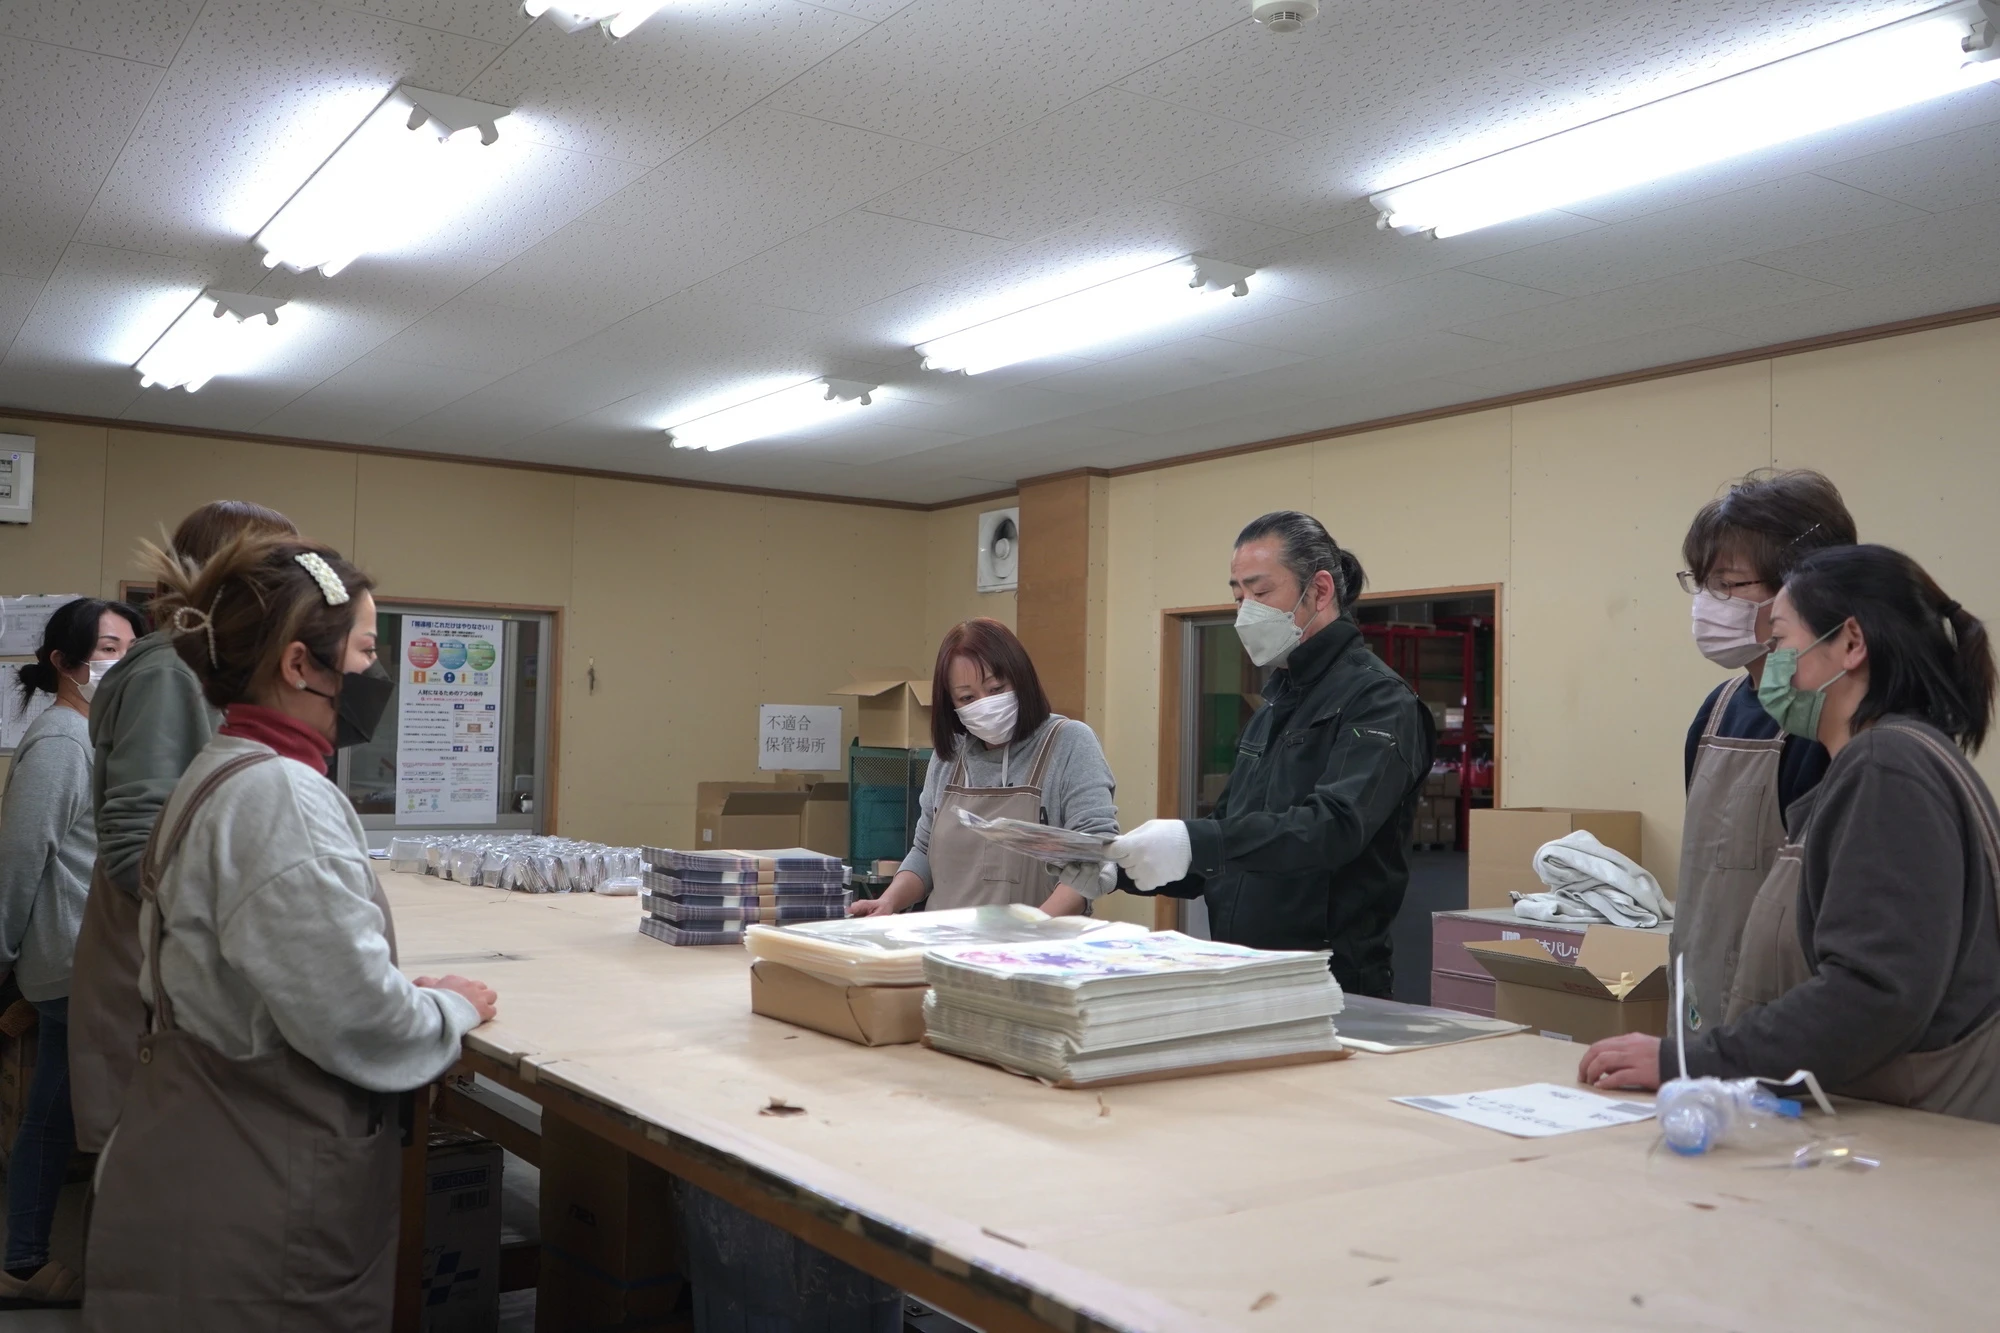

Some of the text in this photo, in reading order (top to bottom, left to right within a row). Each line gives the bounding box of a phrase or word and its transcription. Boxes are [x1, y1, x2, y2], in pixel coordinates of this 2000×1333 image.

[766, 714, 811, 731] 不適合
[765, 736, 826, 753] 保管場所
